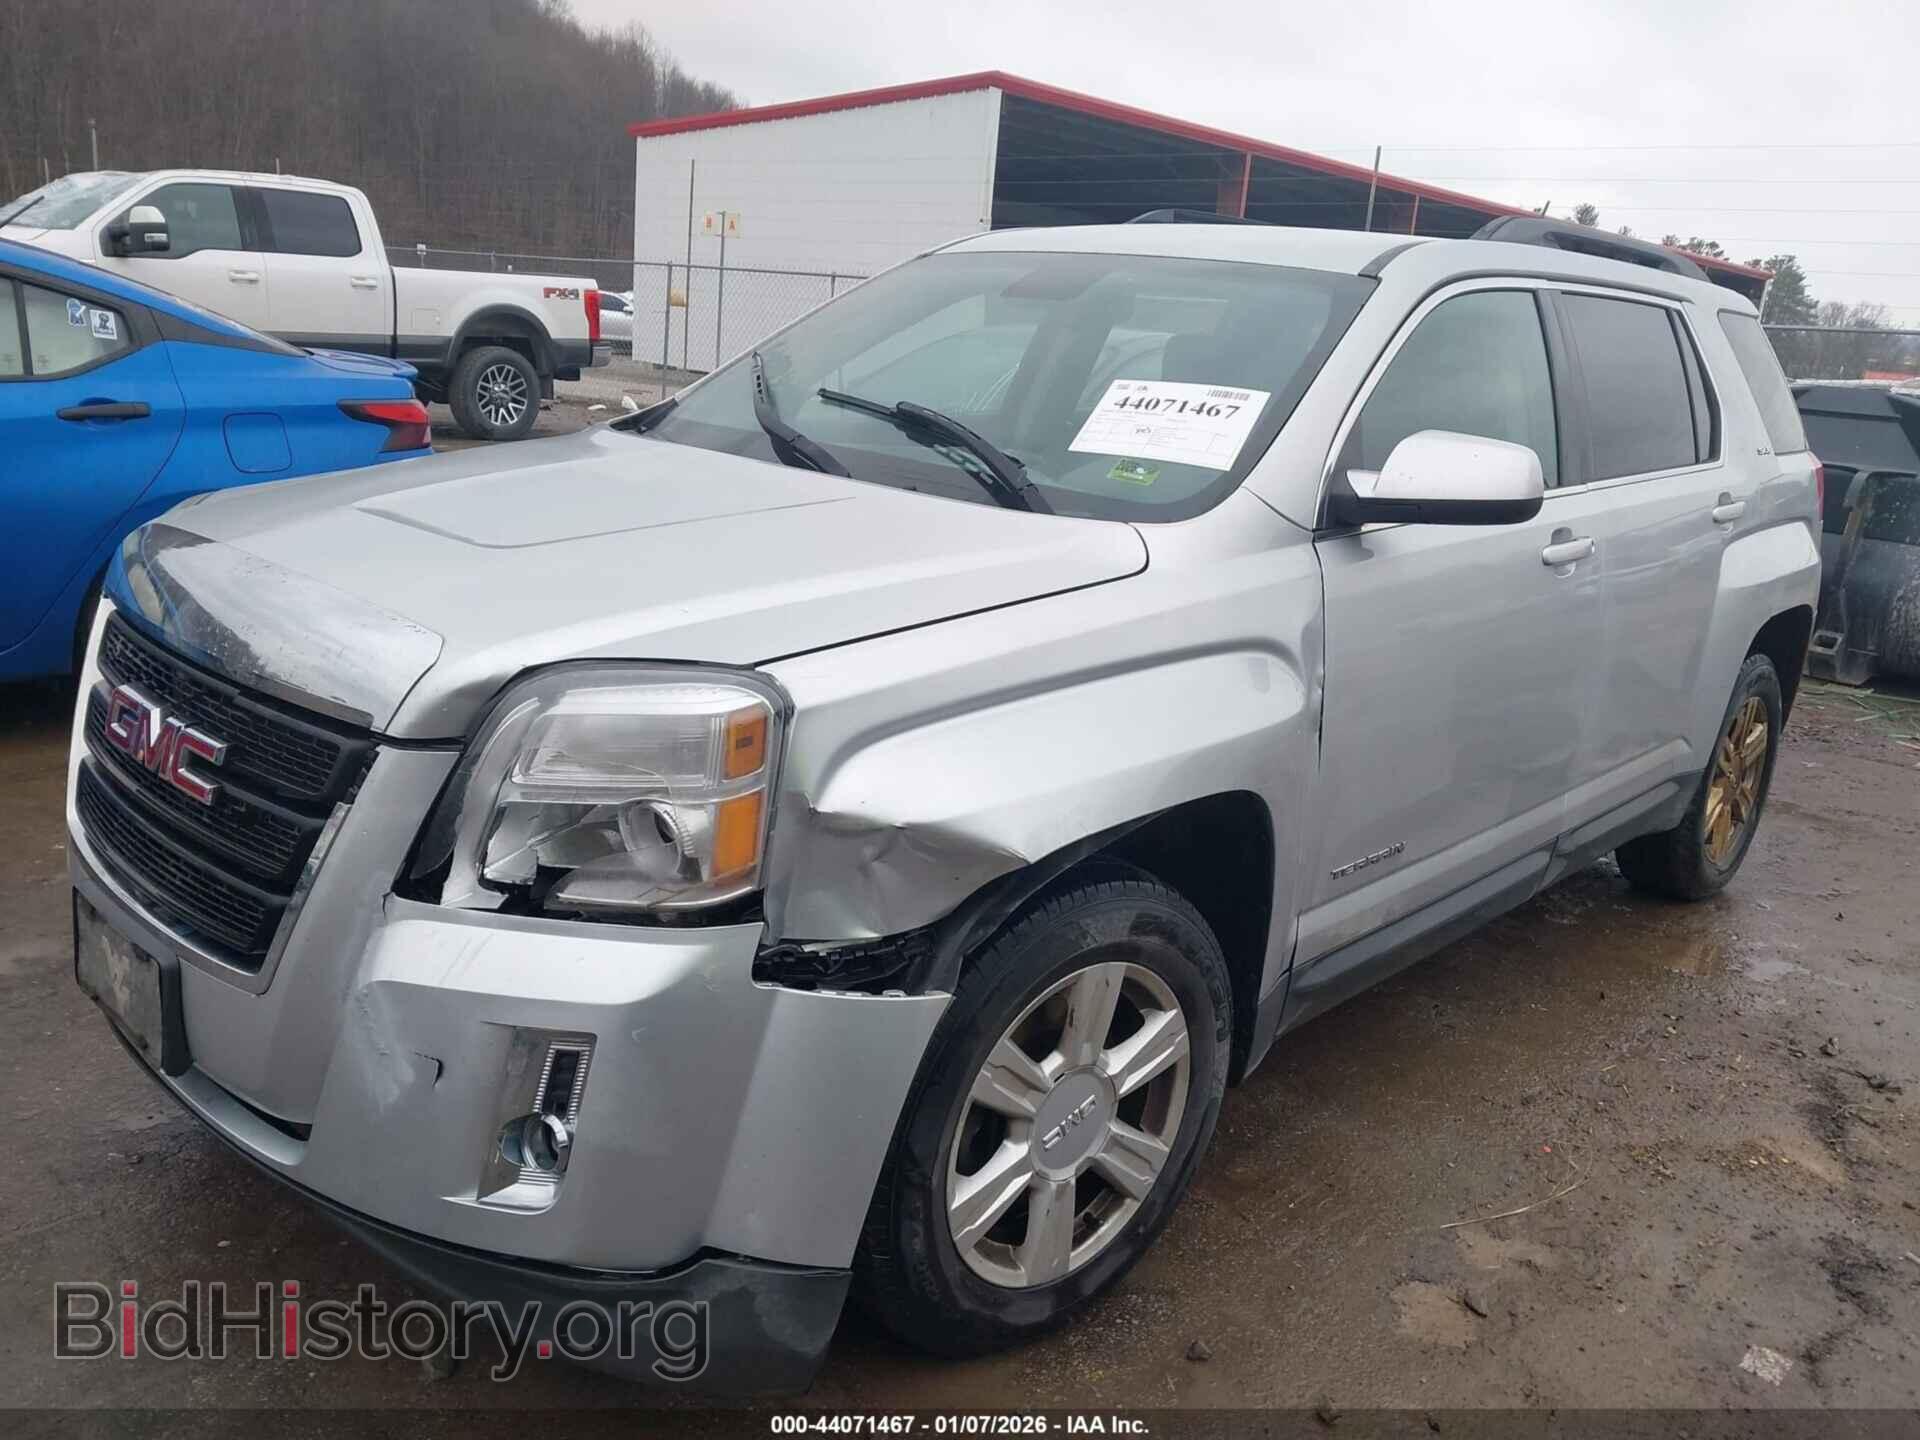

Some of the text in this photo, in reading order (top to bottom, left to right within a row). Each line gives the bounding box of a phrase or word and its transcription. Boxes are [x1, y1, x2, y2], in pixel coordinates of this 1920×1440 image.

[543, 287, 580, 300] FX4
[1114, 396, 1241, 420] 44071467
[105, 684, 228, 806] GMC
[1042, 1093, 1096, 1152] GMC
